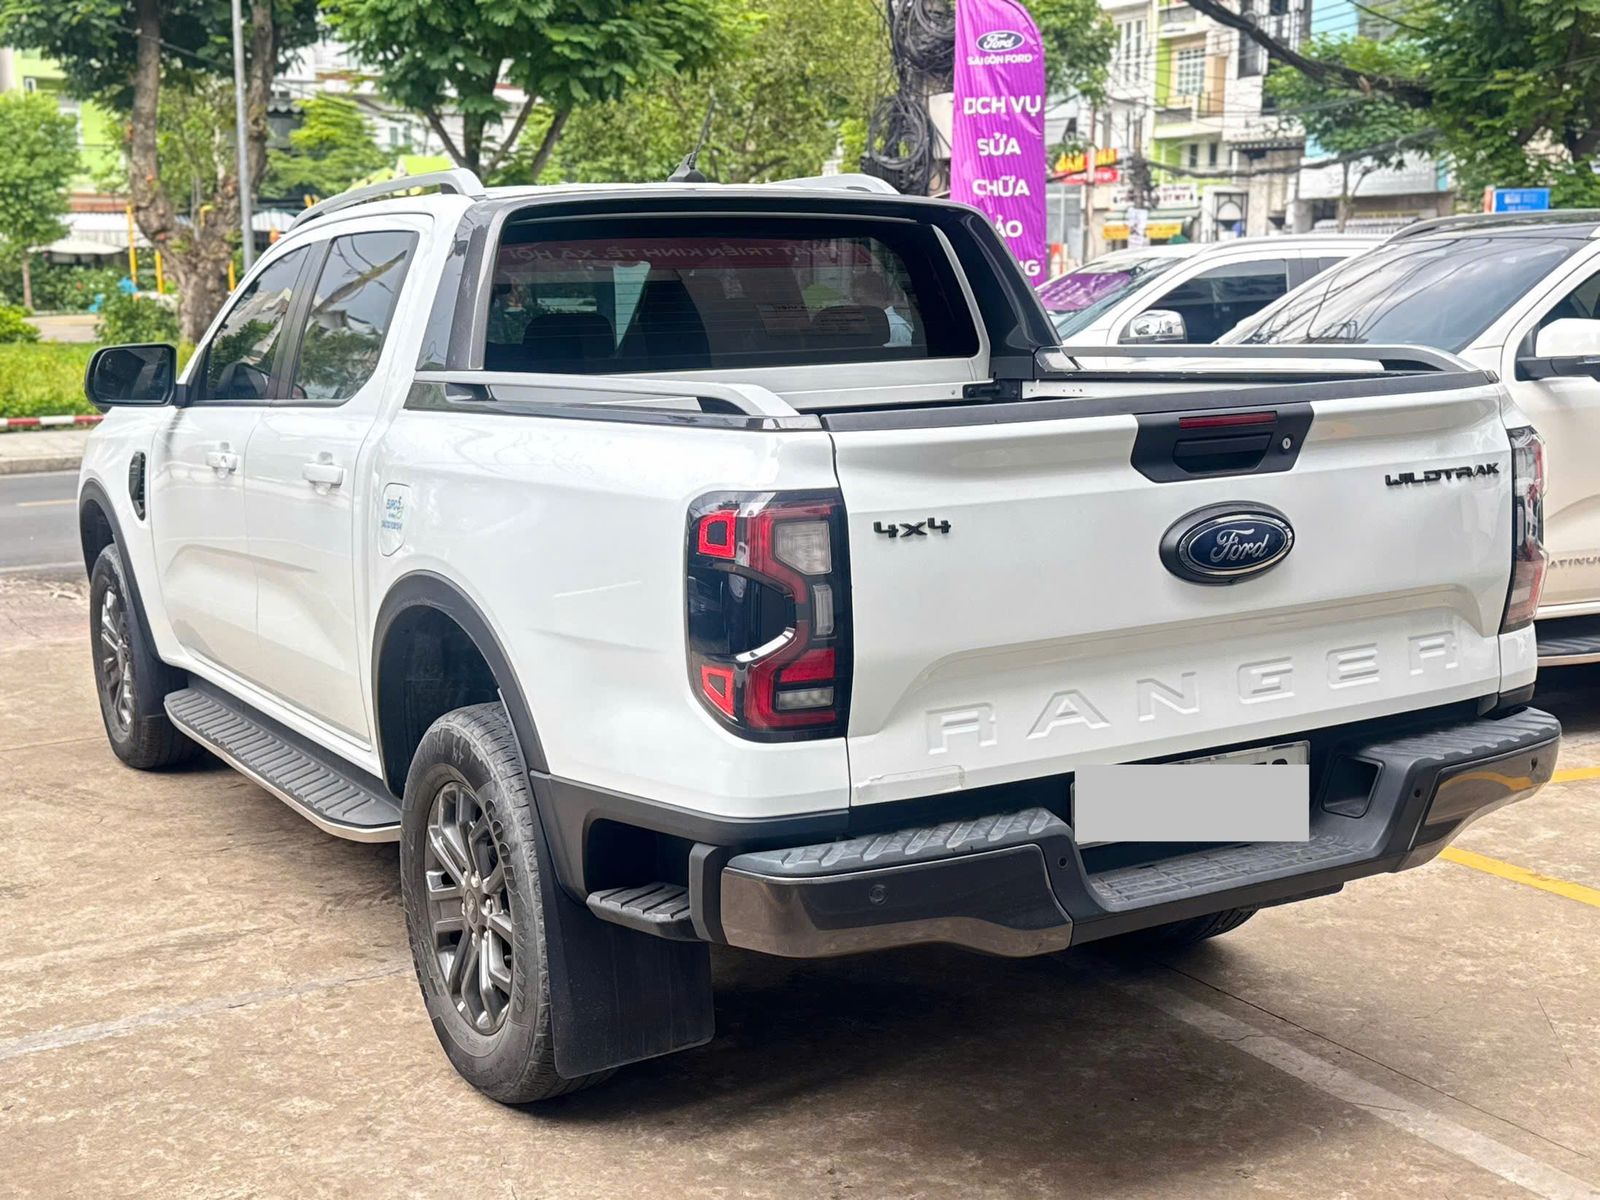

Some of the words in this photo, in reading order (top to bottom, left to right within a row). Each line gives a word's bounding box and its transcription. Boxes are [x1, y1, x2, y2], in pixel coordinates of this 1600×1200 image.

[983, 33, 1015, 49] Ford
[1005, 53, 1033, 64] FORD
[1010, 95, 1041, 117] VỤ
[977, 132, 1022, 156] SỬA
[972, 175, 1031, 197] CHỮA
[995, 214, 1024, 238] ẢO
[1385, 462, 1499, 486] WILDTRAK
[1209, 528, 1269, 563] Ford
[1548, 556, 1600, 569] ATINU
[925, 630, 1459, 755] RANGER
